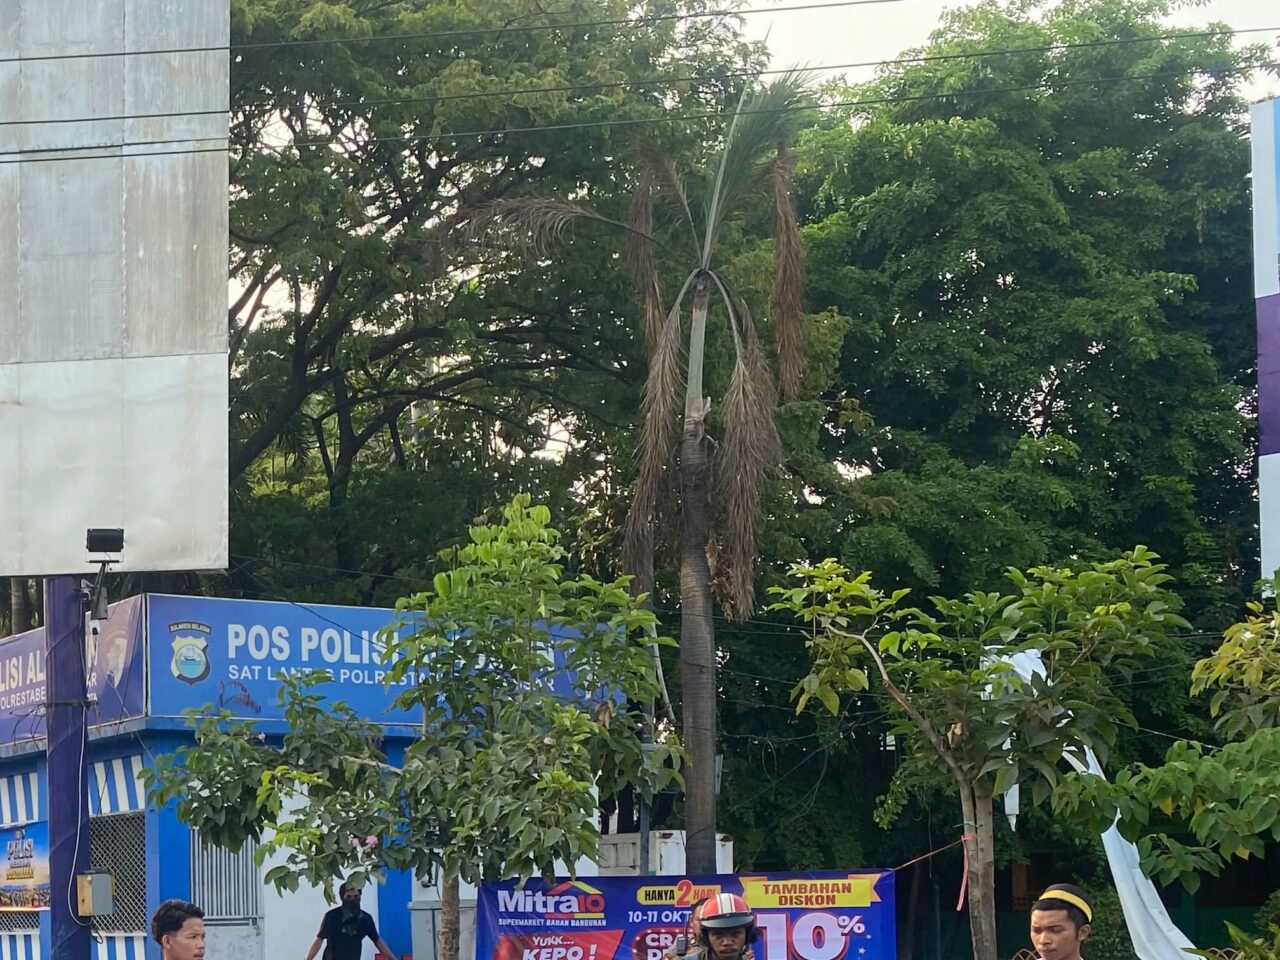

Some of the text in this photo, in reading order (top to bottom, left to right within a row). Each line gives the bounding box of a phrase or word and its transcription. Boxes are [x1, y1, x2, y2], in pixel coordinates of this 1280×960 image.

[228, 623, 290, 661] POS
[301, 627, 399, 665] POLISI
[229, 665, 261, 680] SAT
[644, 889, 675, 901] HANYA
[676, 880, 693, 907] 2
[763, 882, 852, 894] TAMBAHAN
[498, 890, 606, 913] Mitra10
[778, 895, 836, 906] DISKON
[498, 918, 545, 927] SUPERMARKET
[628, 911, 658, 922] 10-11
